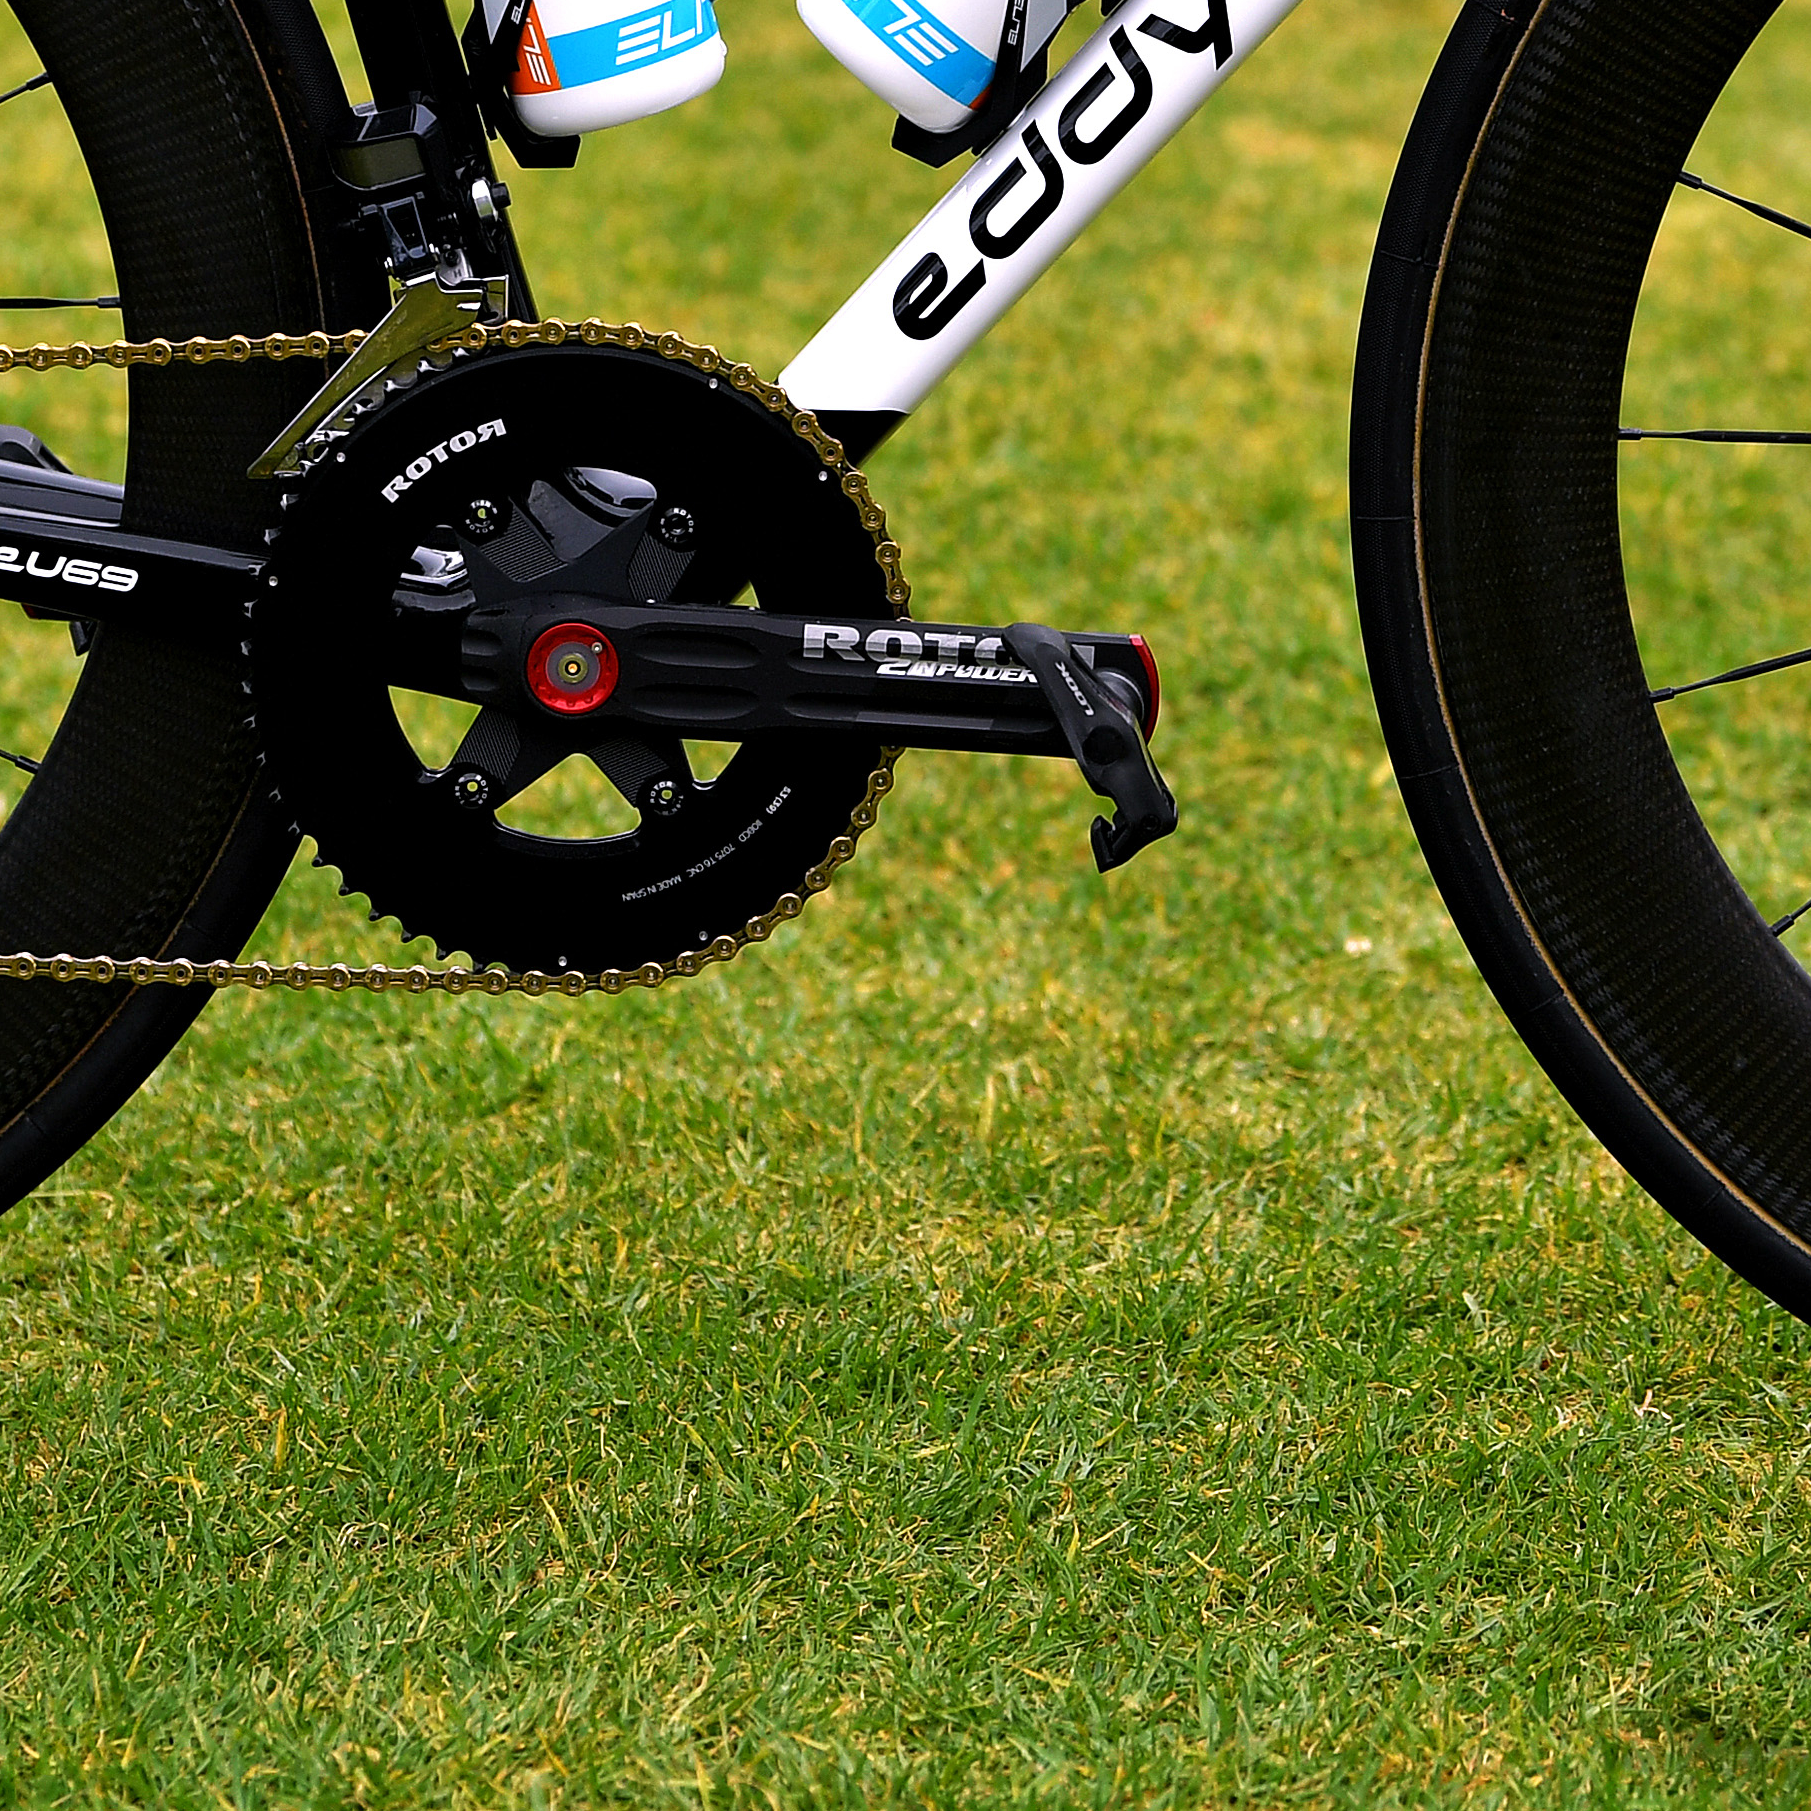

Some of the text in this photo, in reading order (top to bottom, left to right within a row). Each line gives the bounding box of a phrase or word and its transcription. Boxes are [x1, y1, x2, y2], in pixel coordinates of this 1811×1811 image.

[381, 418, 507, 503] ROTOR
[803, 623, 1095, 673] ROTO
[1054, 661, 1095, 716] LOOK
[703, 856, 716, 869] T6
[715, 843, 736, 860] 7075
